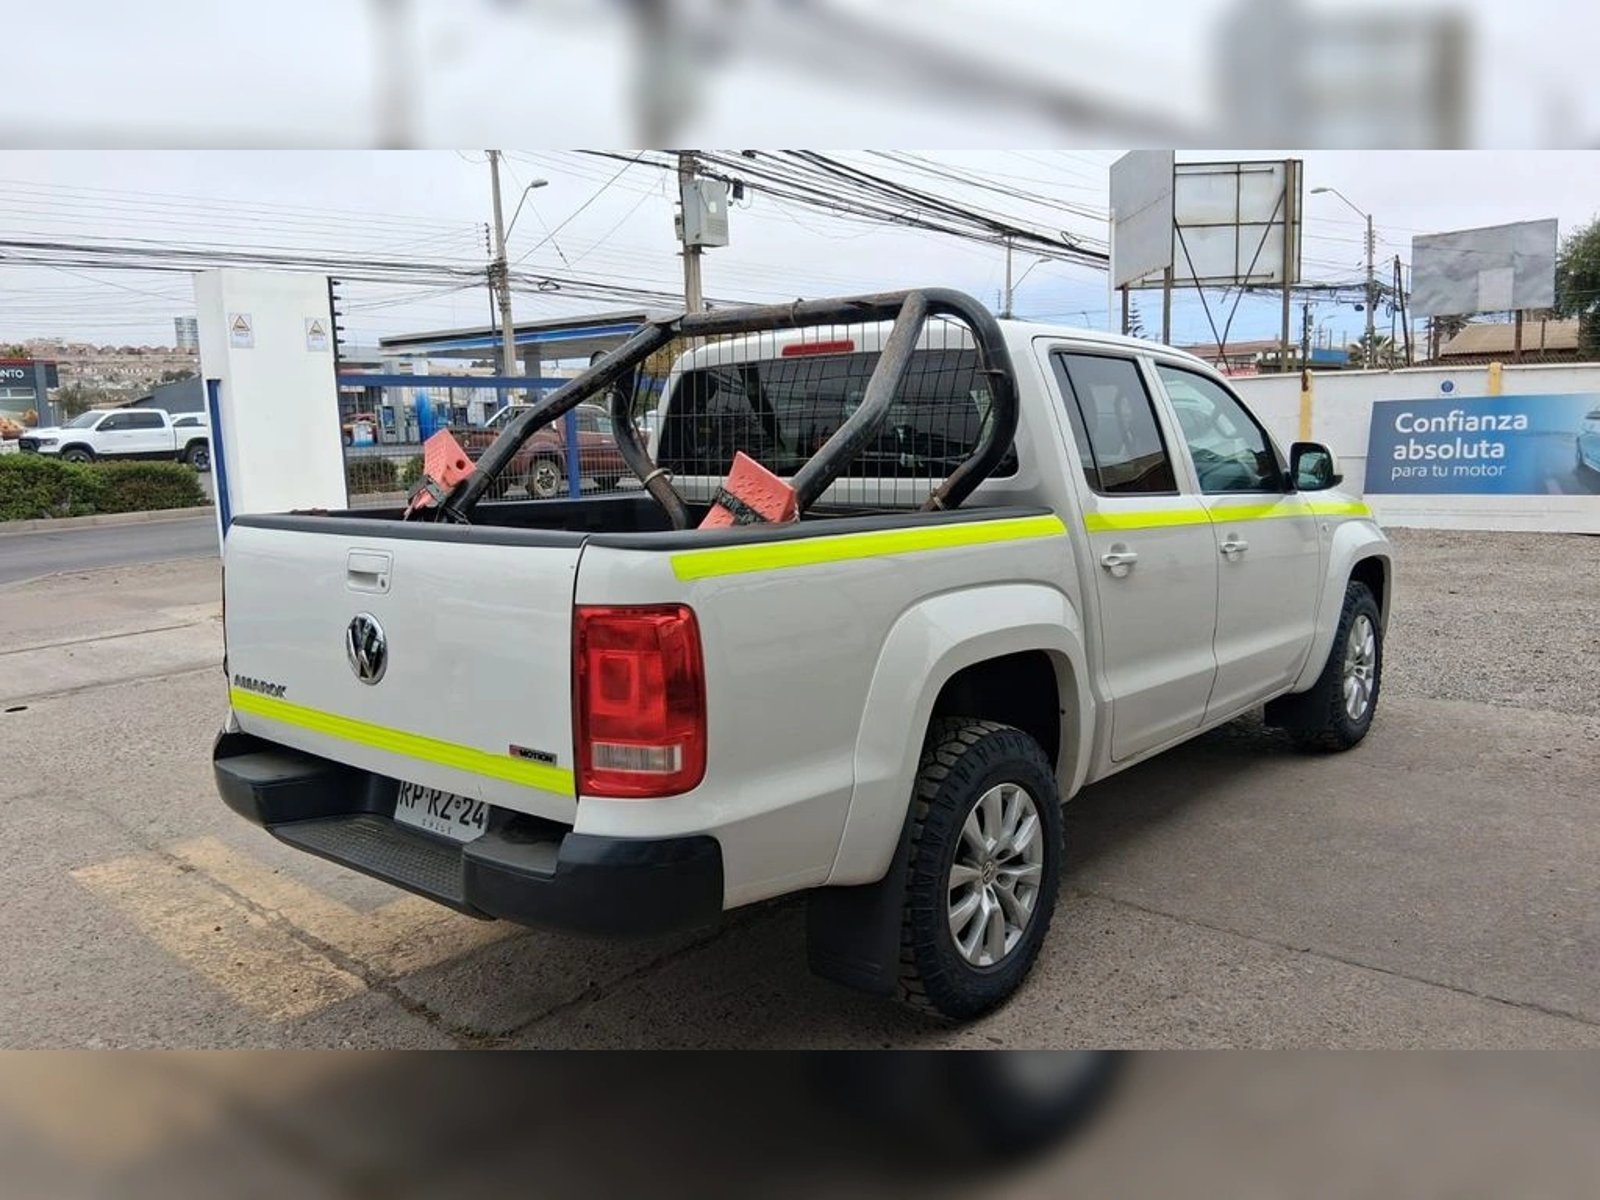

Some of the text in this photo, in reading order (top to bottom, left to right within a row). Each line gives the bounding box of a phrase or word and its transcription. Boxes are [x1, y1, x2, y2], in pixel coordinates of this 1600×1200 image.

[1394, 409, 1528, 434] Confianza
[1393, 437, 1505, 460] absoluta
[1391, 464, 1506, 482] para tu motor
